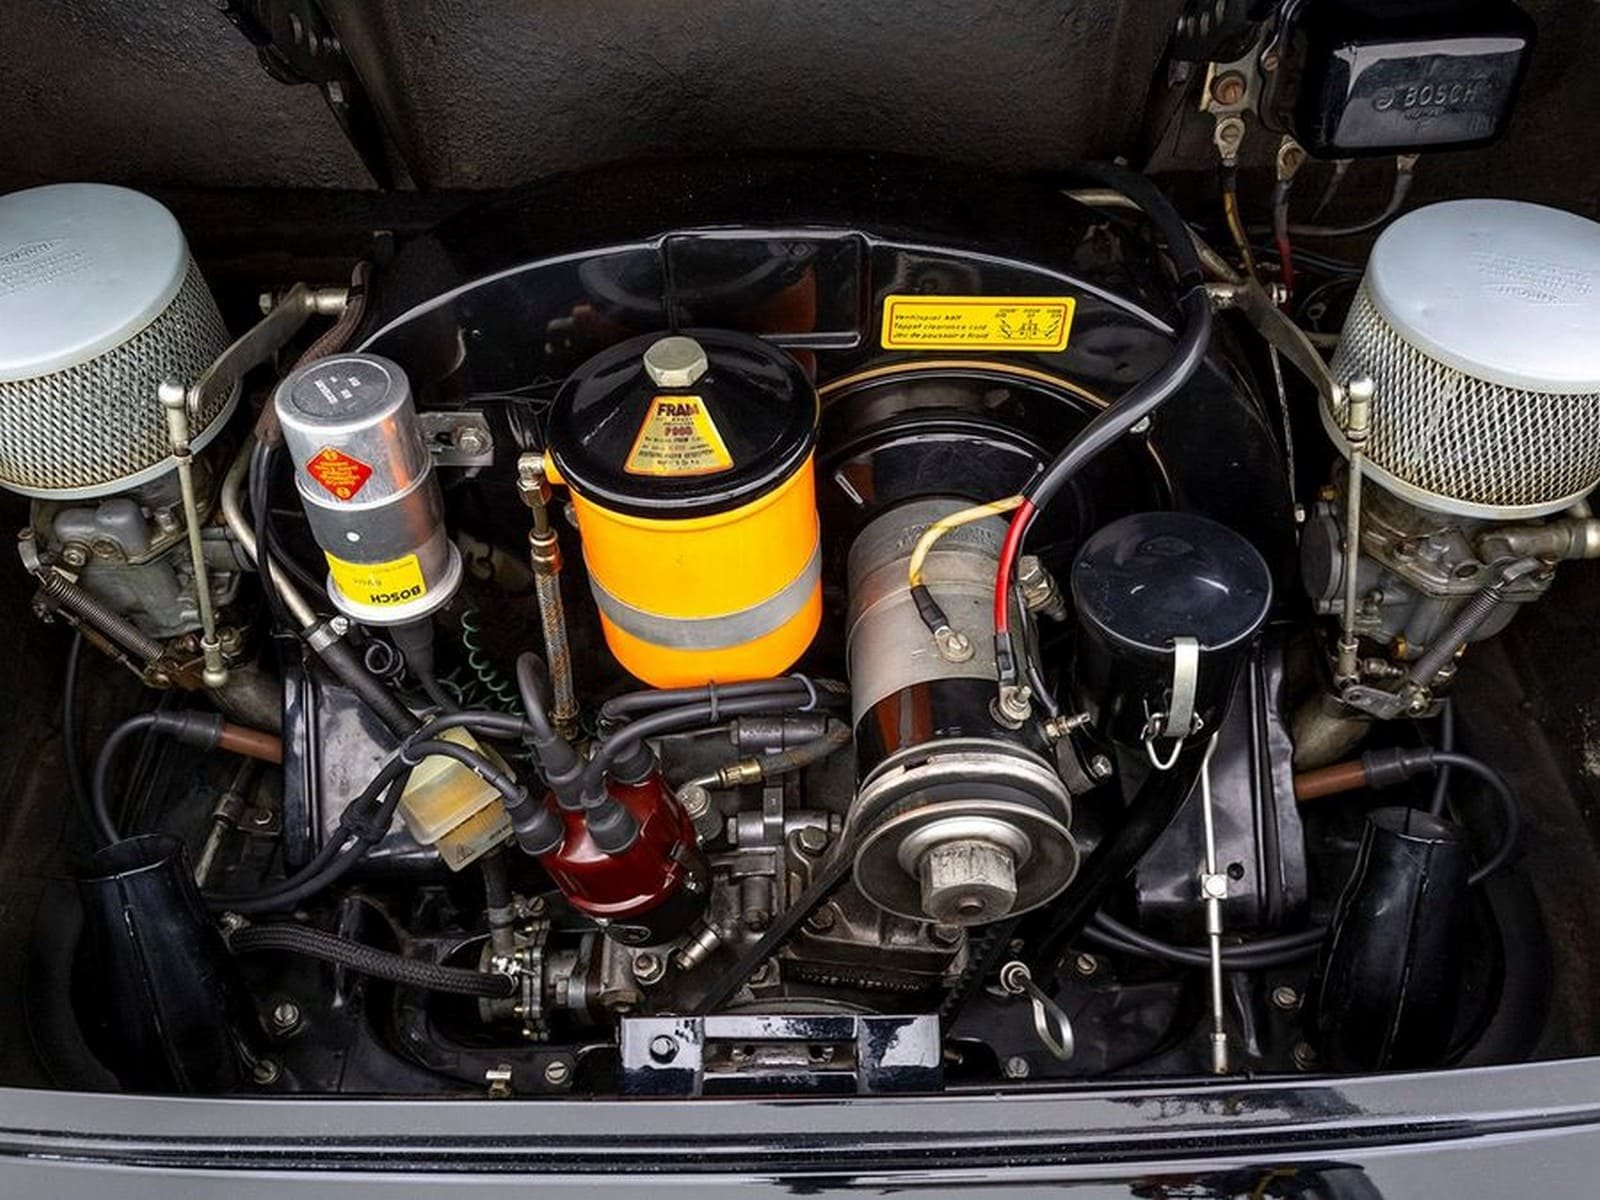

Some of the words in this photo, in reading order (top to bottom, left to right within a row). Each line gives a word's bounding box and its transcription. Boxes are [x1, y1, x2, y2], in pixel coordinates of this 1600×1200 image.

[1404, 82, 1477, 107] BOSCH
[894, 322, 922, 330] Tappet
[657, 403, 700, 417] FRAM
[369, 585, 422, 604] BOSCH
